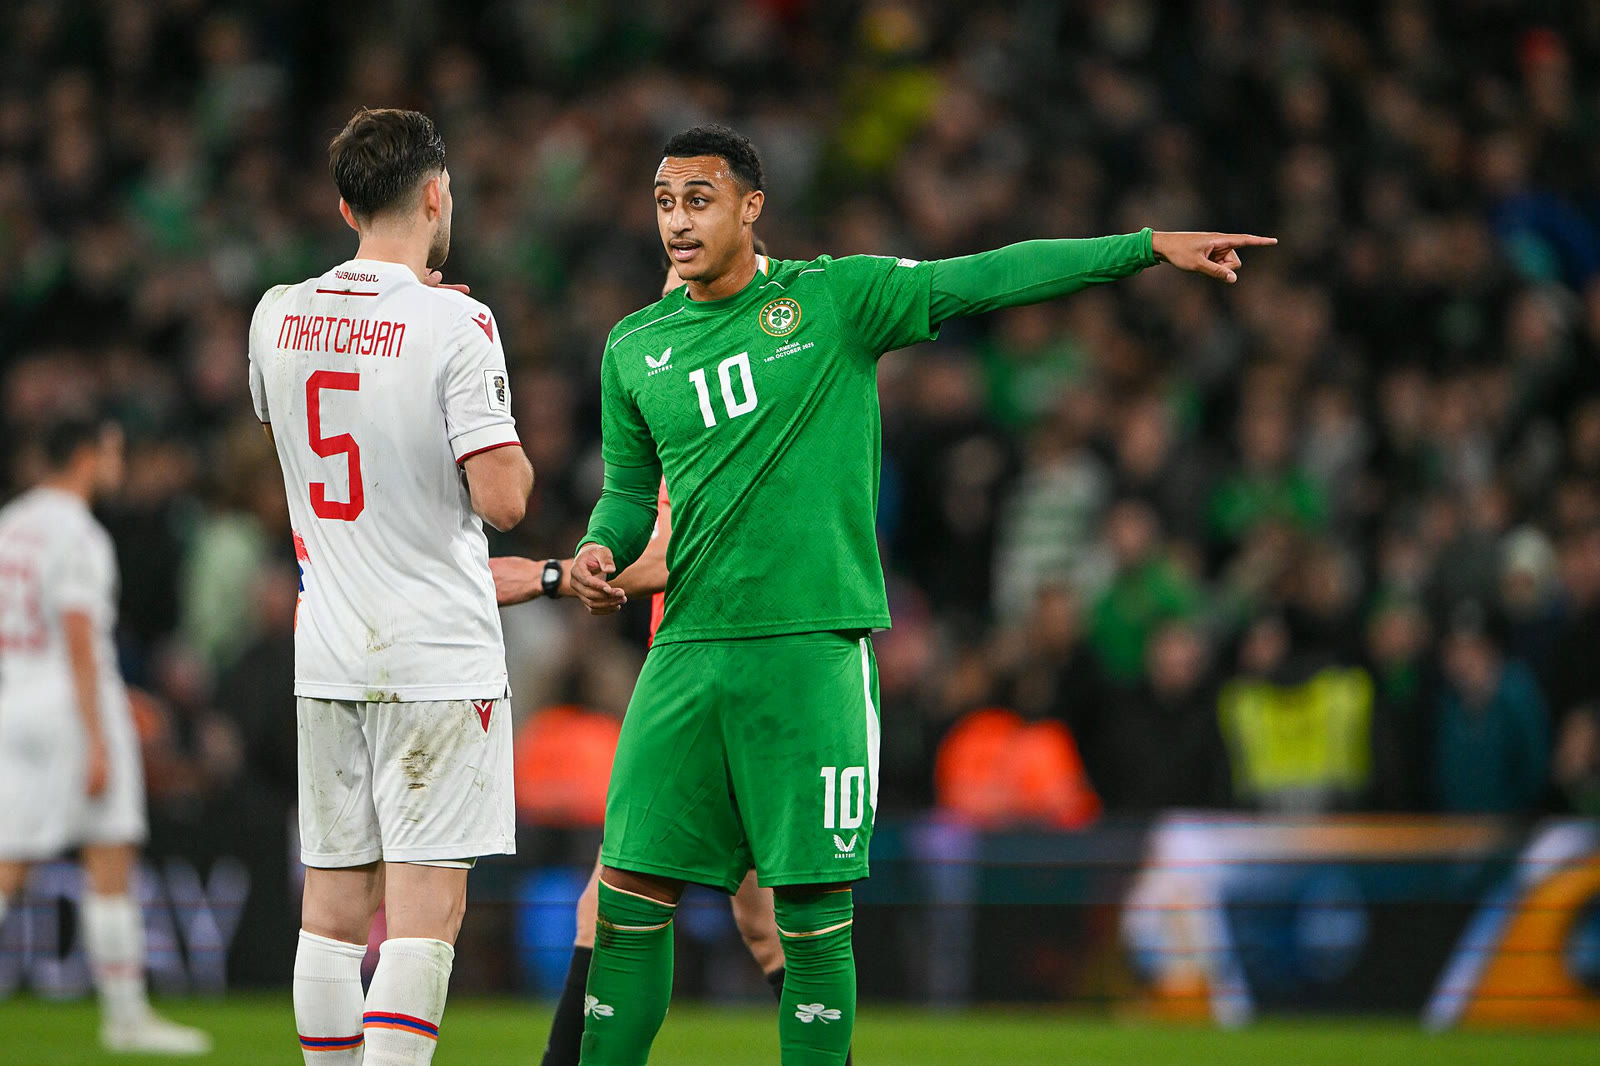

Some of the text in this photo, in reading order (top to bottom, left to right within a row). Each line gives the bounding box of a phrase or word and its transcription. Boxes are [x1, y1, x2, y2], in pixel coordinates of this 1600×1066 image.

[763, 301, 795, 317] IRELAND
[277, 314, 406, 357] MKRTCHYAN
[775, 341, 800, 353] ARMENIA
[776, 346, 801, 359] OCTOBER
[688, 351, 758, 428] 10
[306, 370, 364, 521] 5
[820, 766, 865, 829] 10
